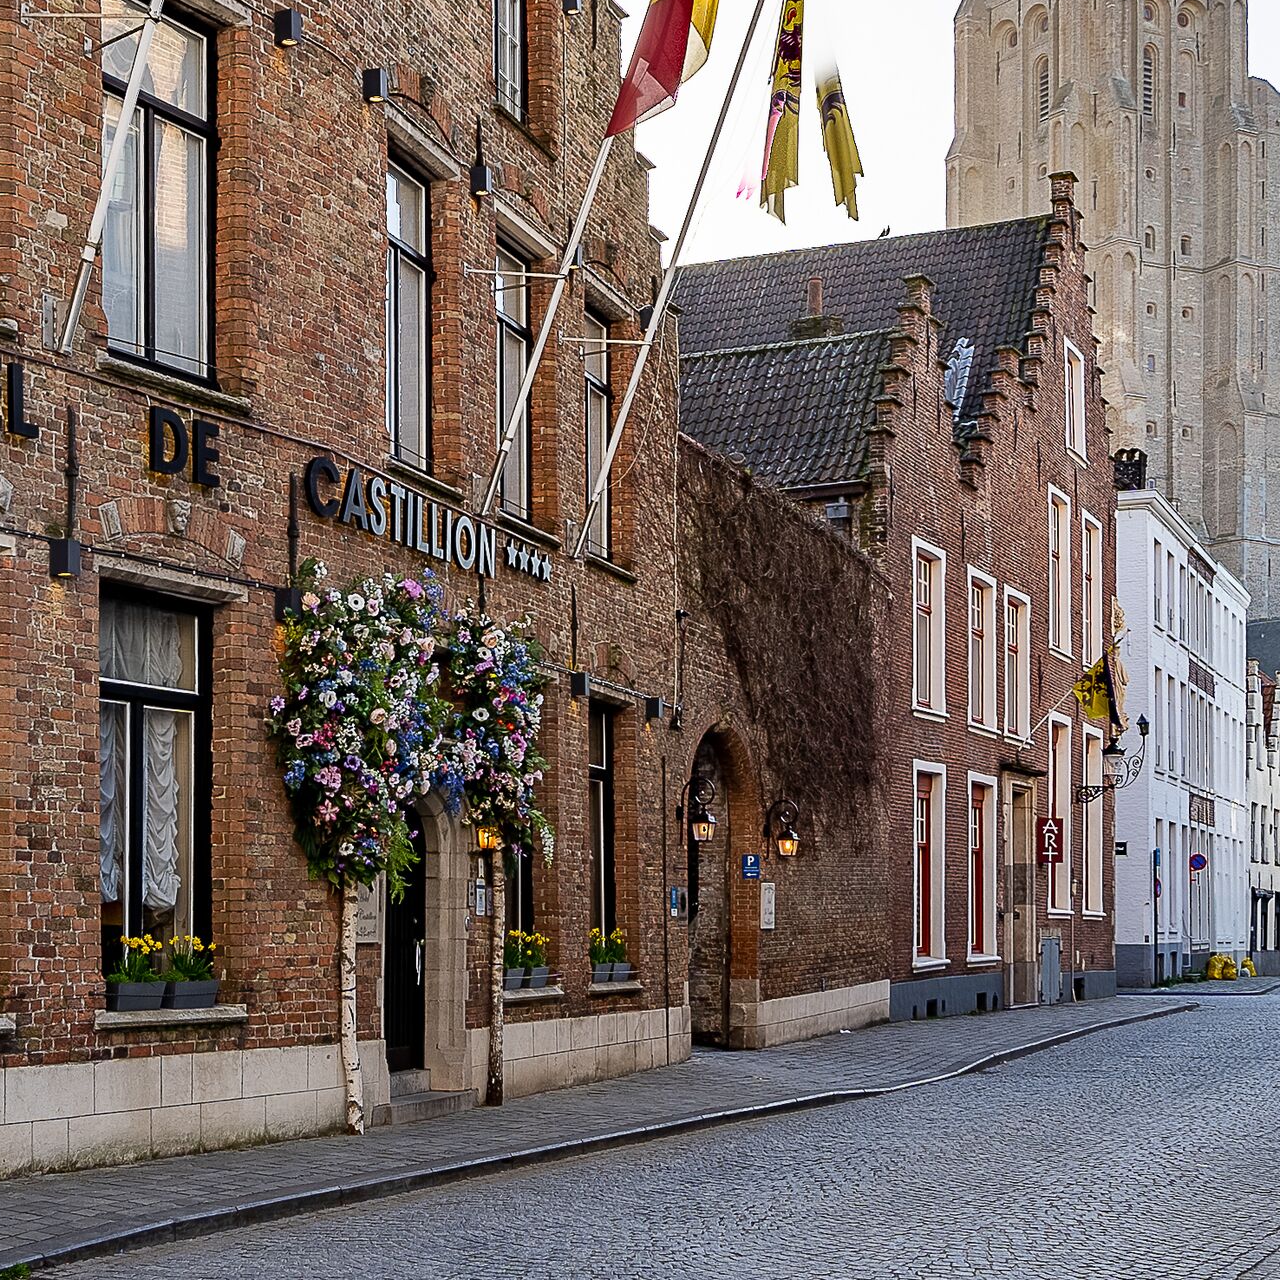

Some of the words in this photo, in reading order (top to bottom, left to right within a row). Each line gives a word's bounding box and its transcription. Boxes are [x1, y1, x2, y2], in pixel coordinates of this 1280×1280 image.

[149, 406, 220, 487] DE
[304, 456, 495, 579] CASTILLION
[747, 855, 755, 866] P
